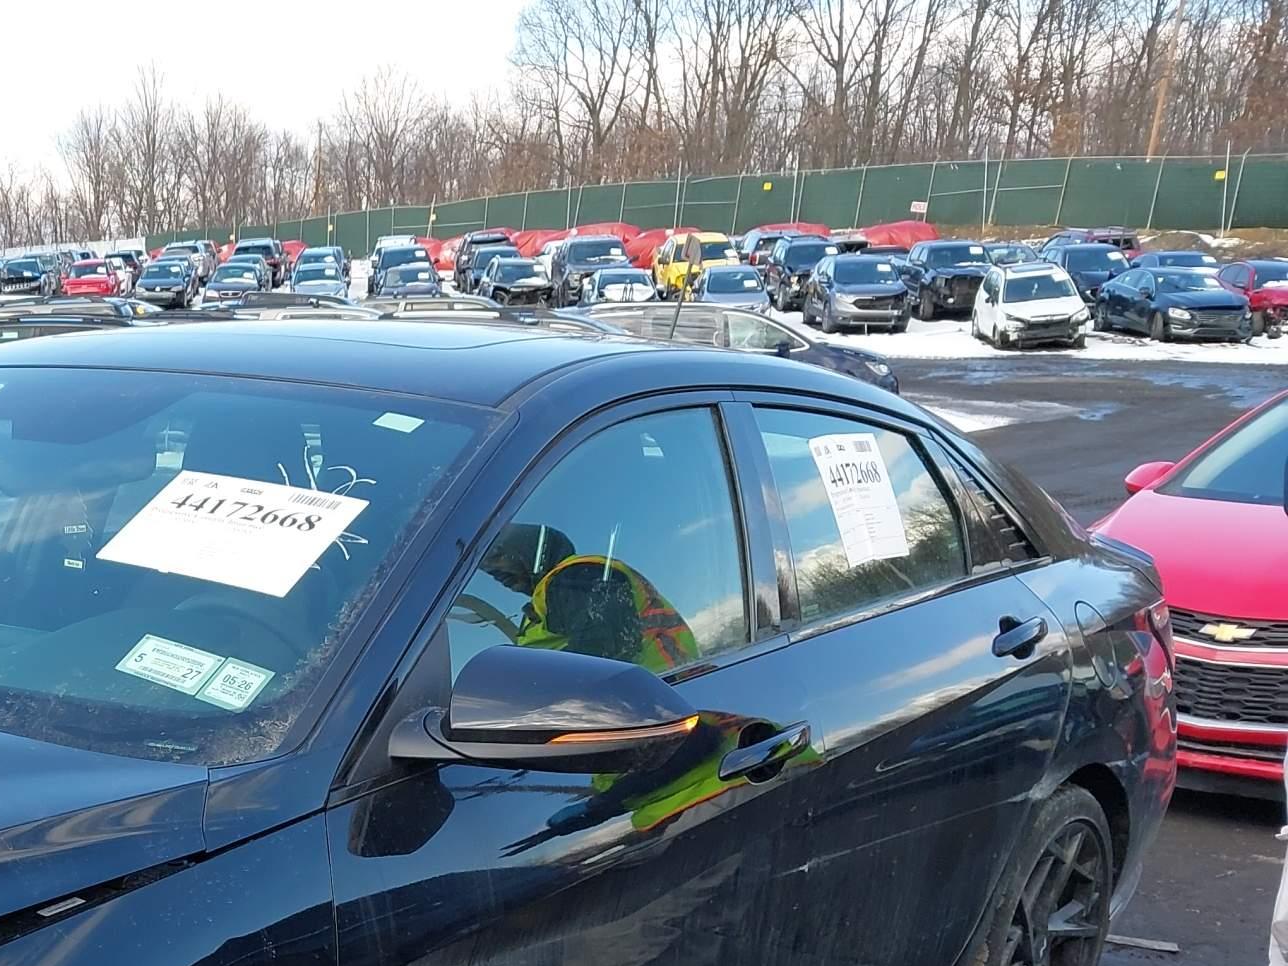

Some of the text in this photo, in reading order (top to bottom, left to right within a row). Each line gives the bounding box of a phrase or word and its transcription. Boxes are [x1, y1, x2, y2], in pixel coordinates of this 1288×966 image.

[829, 460, 881, 487] 44172668
[170, 493, 323, 532] 44172668
[134, 652, 148, 663] 5
[181, 667, 202, 681] 27
